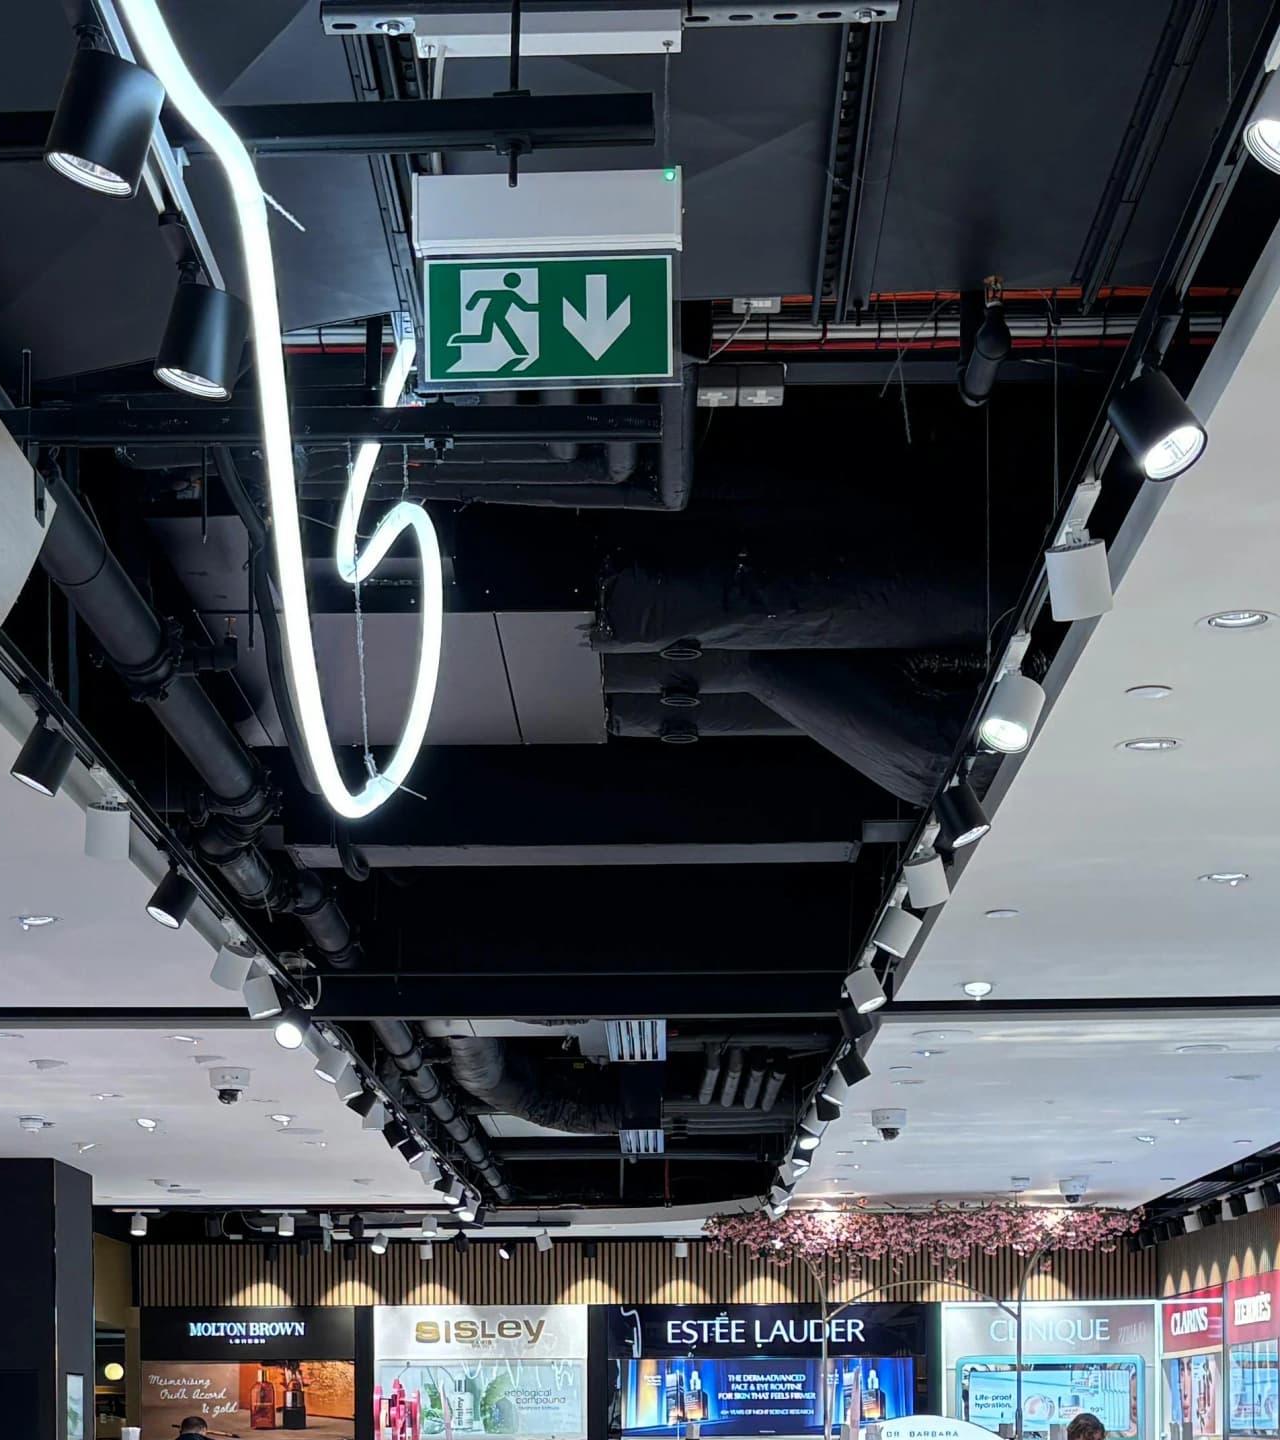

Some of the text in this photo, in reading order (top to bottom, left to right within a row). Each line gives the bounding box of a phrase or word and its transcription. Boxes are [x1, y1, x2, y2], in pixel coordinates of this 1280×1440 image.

[1171, 1306, 1208, 1336] CLARINS
[189, 1322, 305, 1336] MOLTON BROWN
[667, 1315, 865, 1344] ESTÉE LAUDER
[148, 1375, 212, 1389] Mesmerising
[728, 1374, 742, 1382] THE
[731, 1383, 748, 1391] FACE
[756, 1383, 769, 1391] EYE
[770, 1383, 802, 1391] ROUTINE
[193, 1387, 227, 1400] Accord
[504, 1388, 552, 1400] ecological
[718, 1392, 816, 1400] FOR SKIN THAT FEELS FIRMER
[974, 1393, 1013, 1402] Life-proof
[515, 1396, 566, 1406] compound
[213, 1403, 239, 1418] gold
